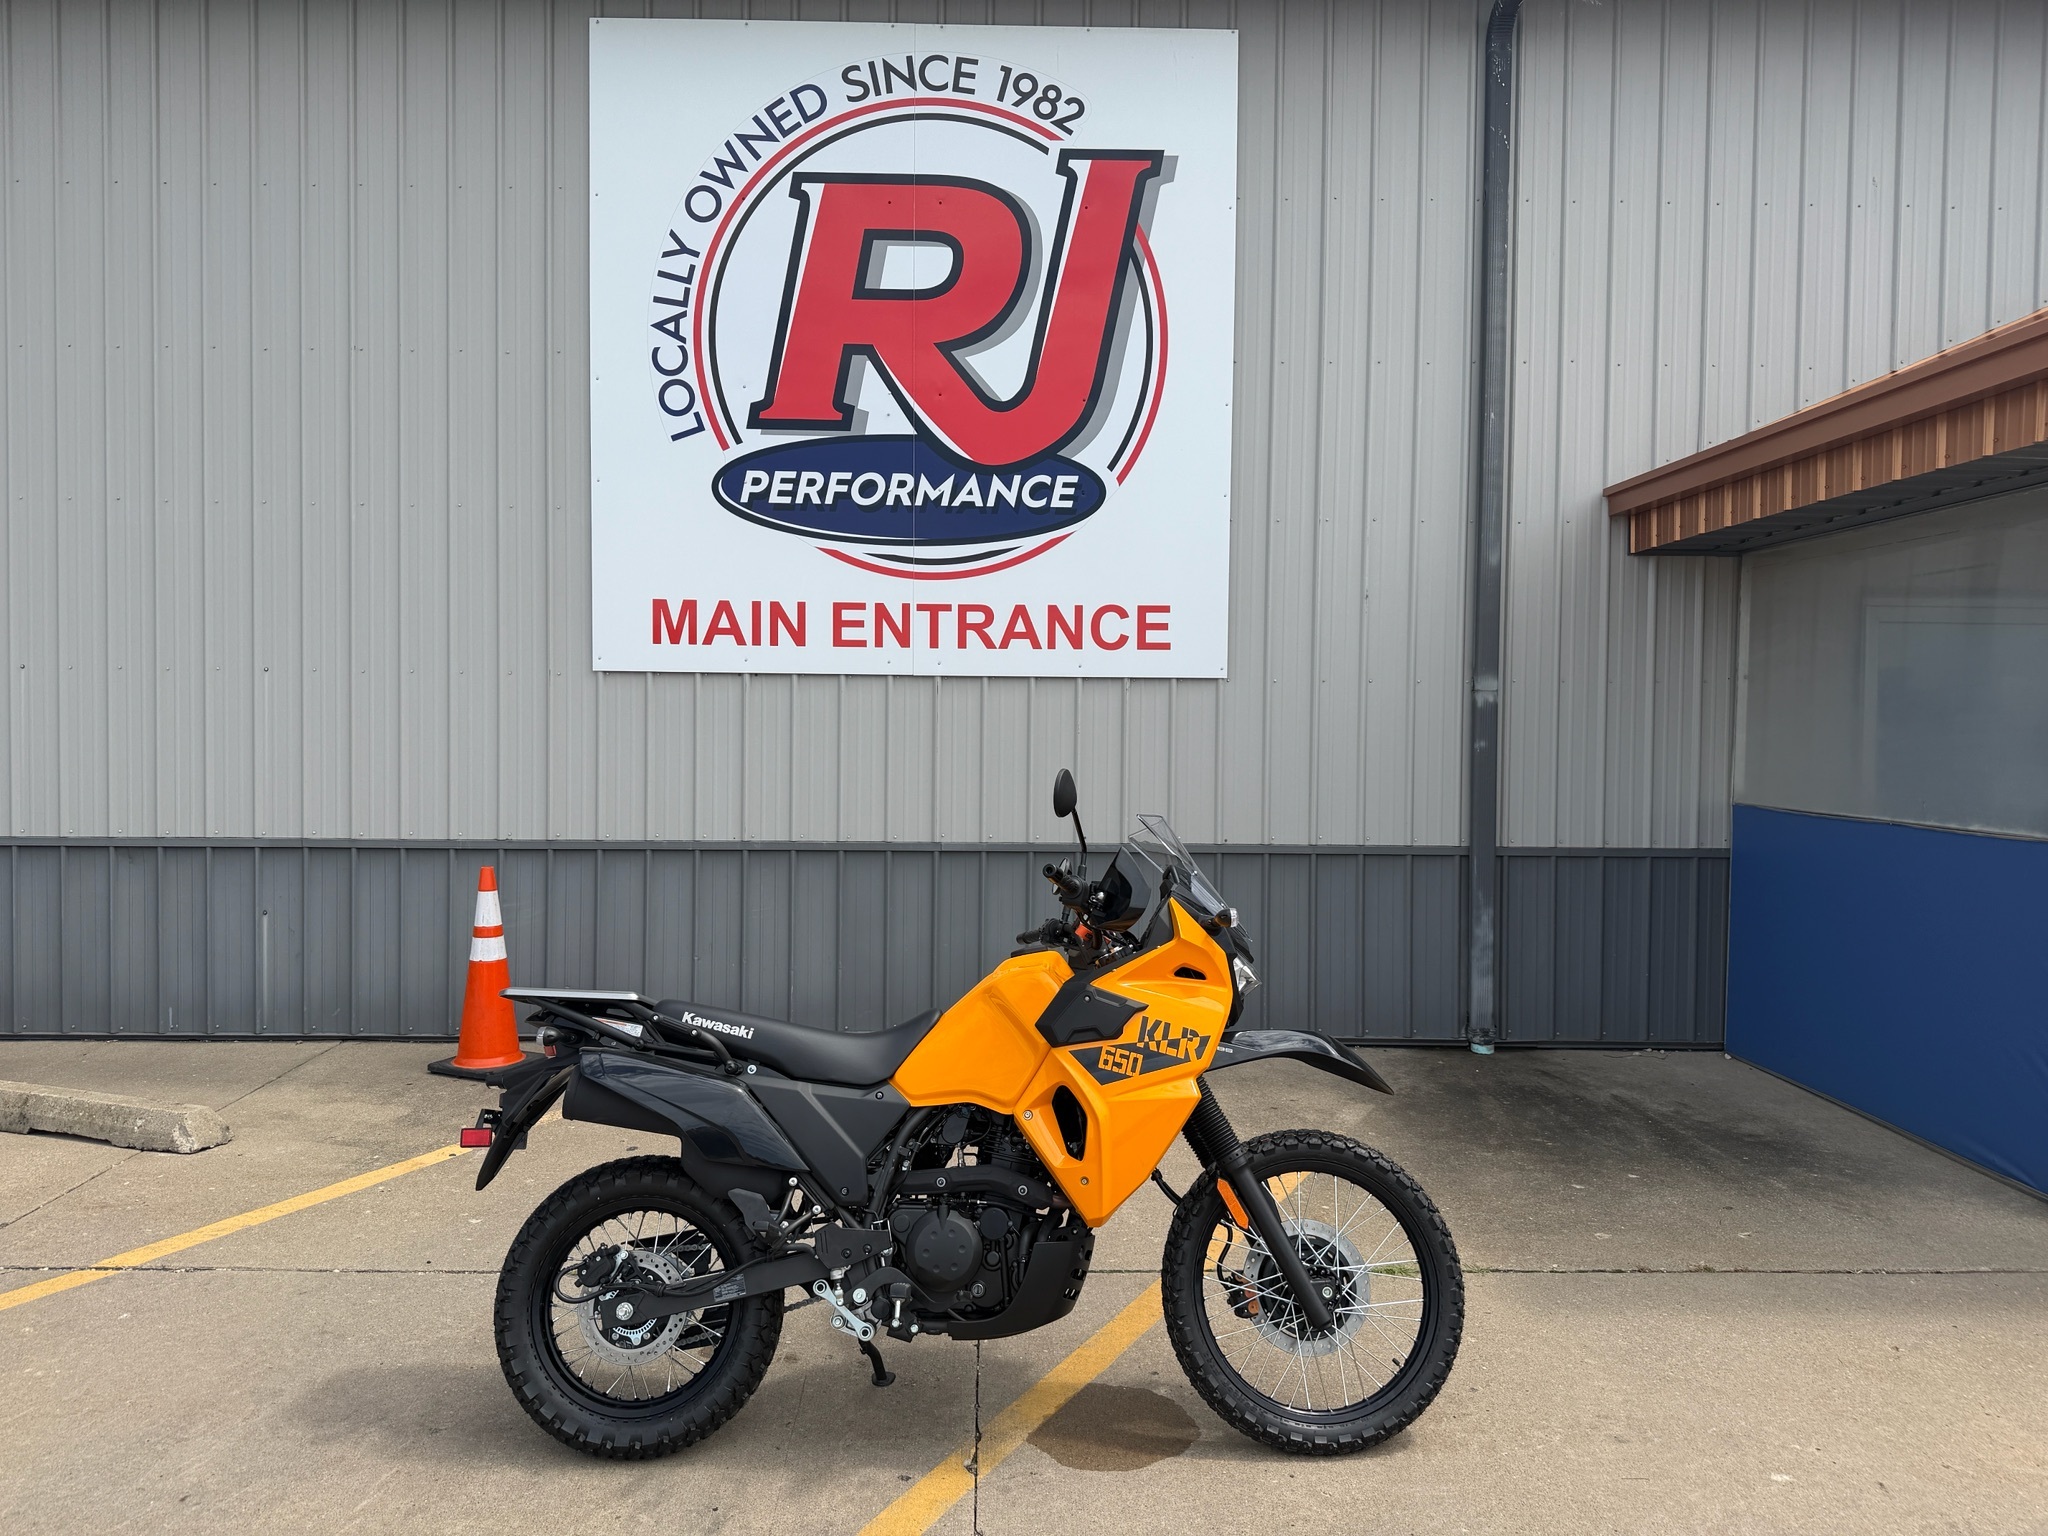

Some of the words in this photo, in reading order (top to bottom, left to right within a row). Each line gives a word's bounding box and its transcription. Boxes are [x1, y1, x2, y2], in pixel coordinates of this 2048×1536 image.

[650, 229, 706, 442] LOCALLY
[685, 83, 829, 223] OWNED
[842, 54, 980, 102] SINCE
[998, 66, 1086, 135] 1982
[747, 149, 1166, 467] RJ
[740, 470, 1079, 508] PERFORMANCE
[652, 599, 807, 647] MAIN
[832, 602, 1172, 651] ENTRANCE
[681, 1011, 754, 1039] Kawasaki
[1137, 1016, 1201, 1062] KLR
[1099, 1047, 1144, 1077] 650
